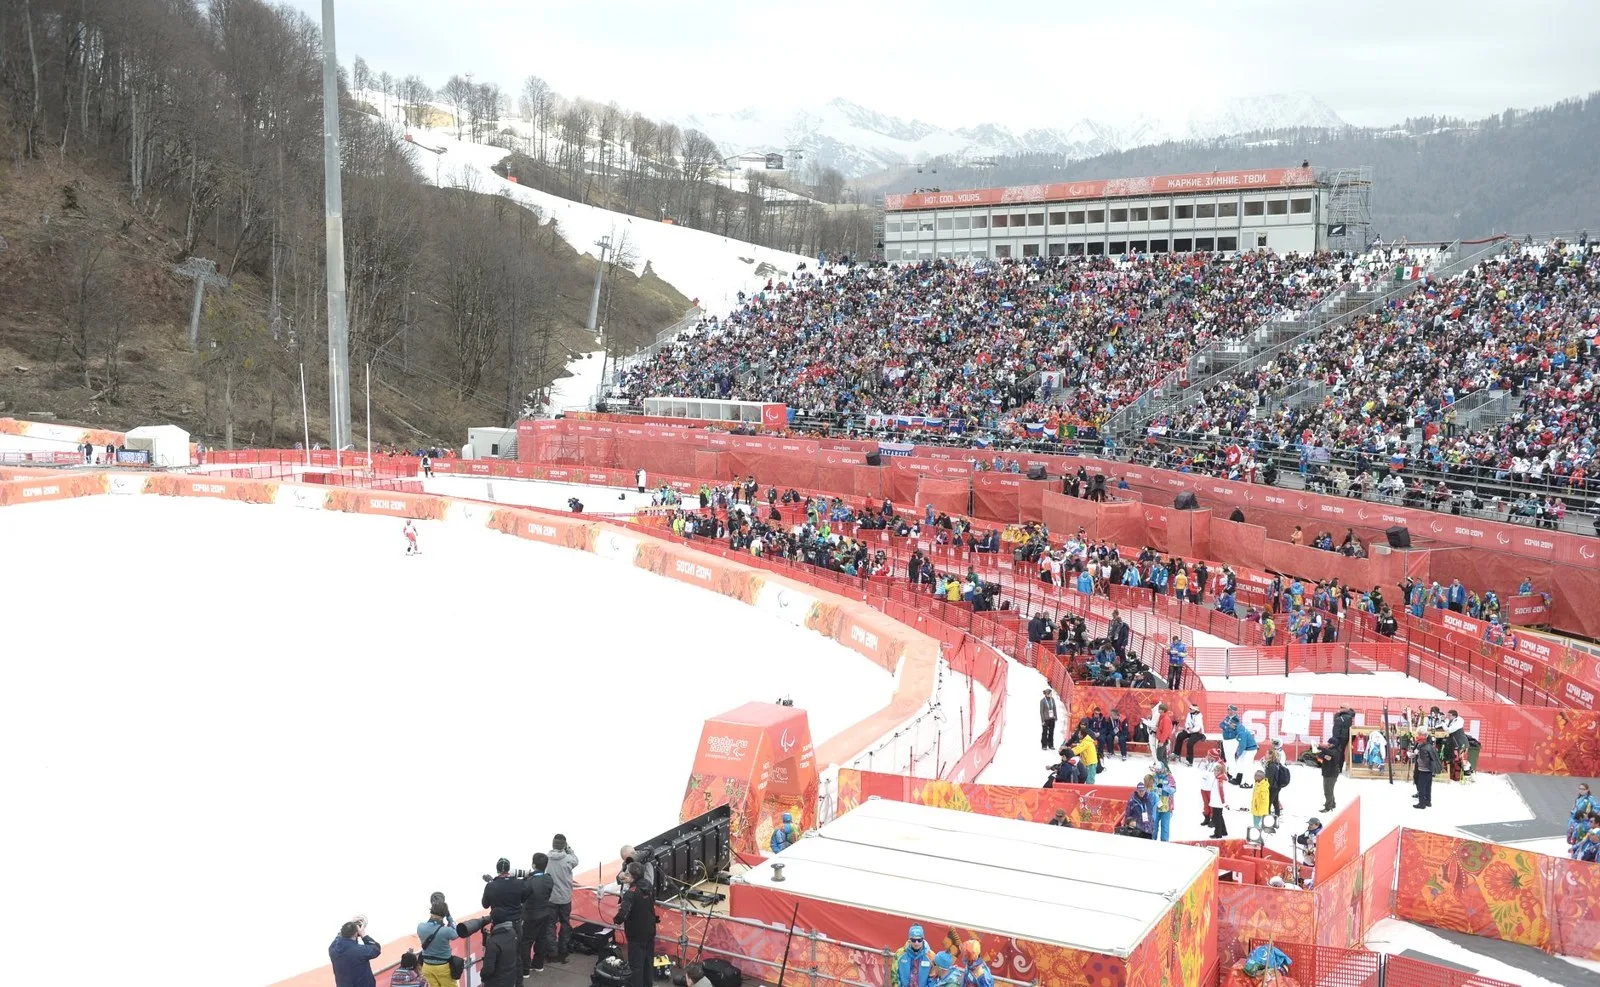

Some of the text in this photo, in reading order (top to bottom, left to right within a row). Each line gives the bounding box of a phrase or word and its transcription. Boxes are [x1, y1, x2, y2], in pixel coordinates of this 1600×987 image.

[676, 559, 712, 581] SOCHI 2014
[1444, 615, 1462, 627] SOCHI
[1463, 620, 1478, 632] 2014
[1520, 639, 1536, 652] СОЧИ
[1536, 645, 1550, 656] 2014
[1503, 654, 1519, 668] SOCHI
[1520, 660, 1533, 673] 2014
[1566, 682, 1581, 698] СОЧИ
[1581, 689, 1594, 704] 2014
